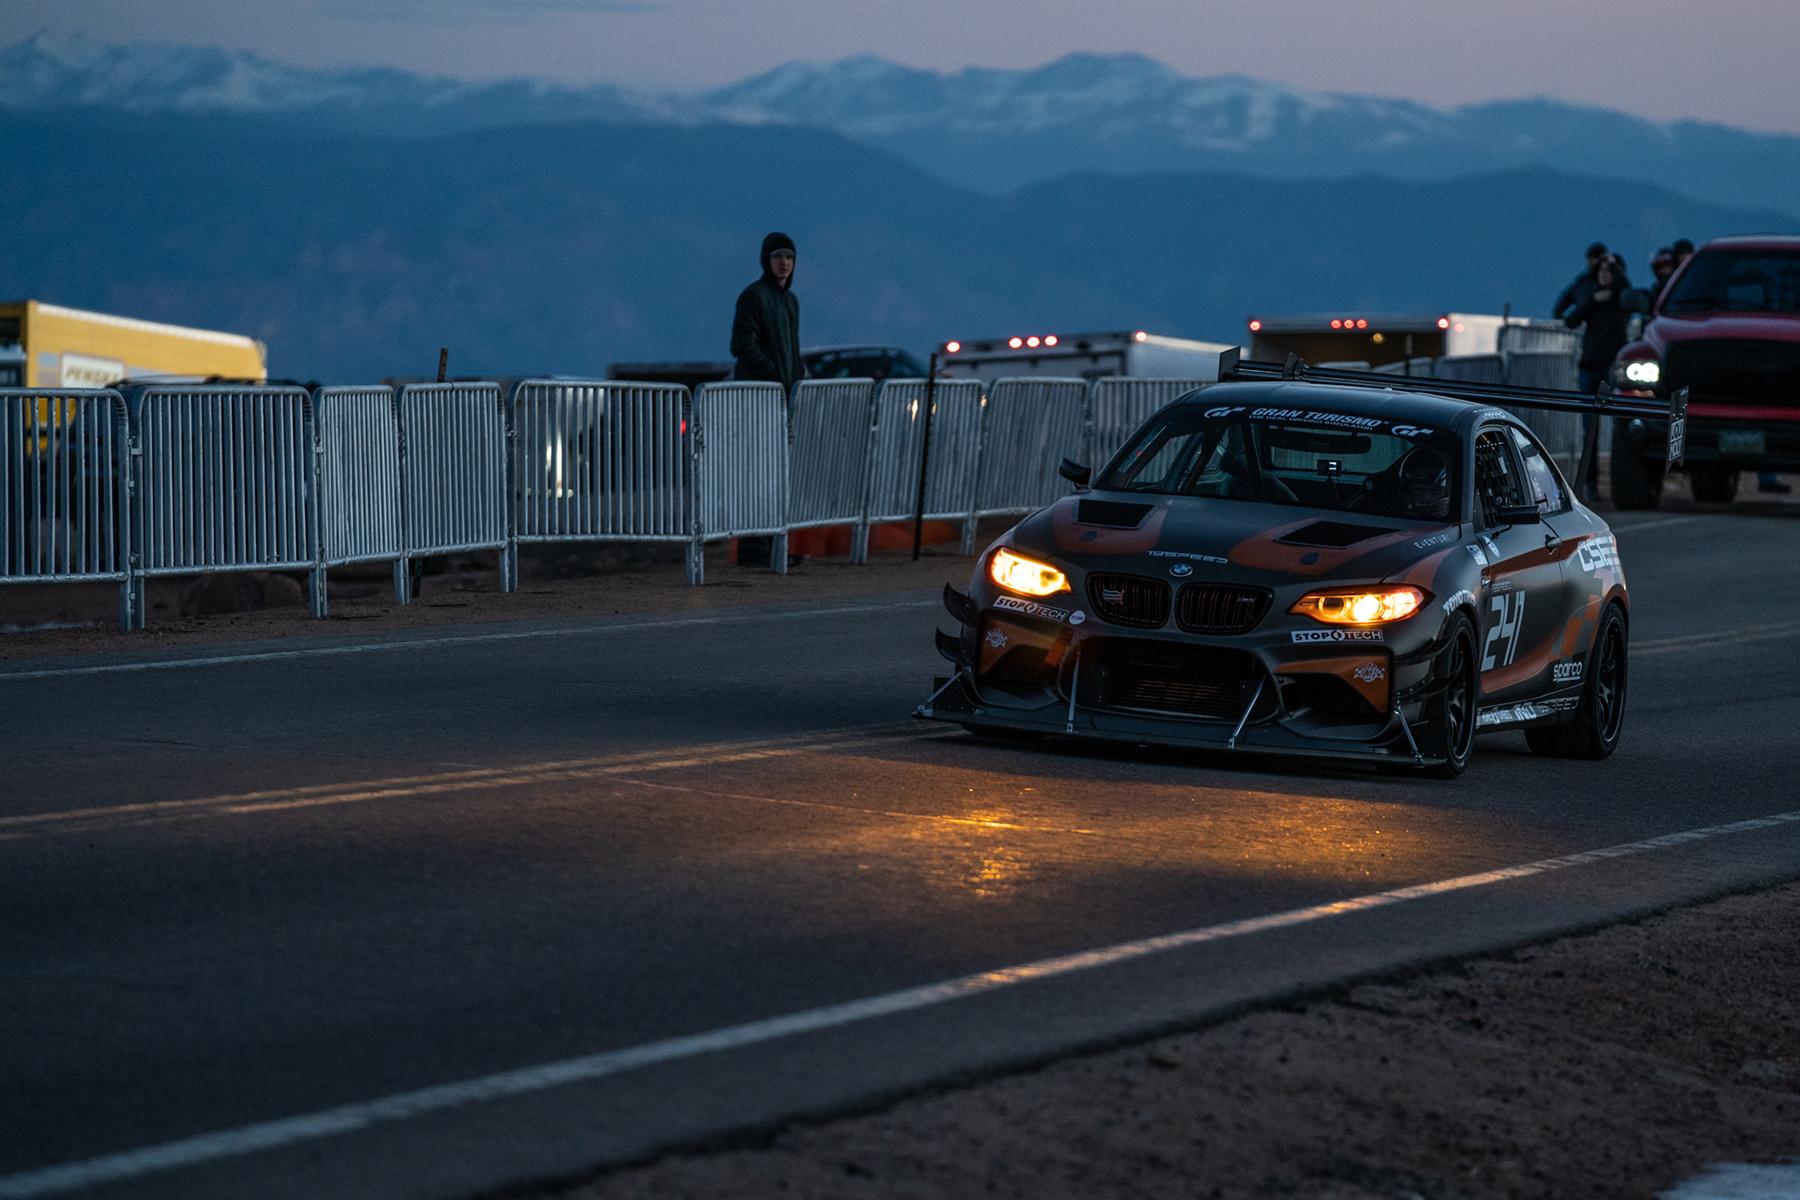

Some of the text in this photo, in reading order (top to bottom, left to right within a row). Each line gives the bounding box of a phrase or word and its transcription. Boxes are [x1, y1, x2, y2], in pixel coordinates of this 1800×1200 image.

[1251, 407, 1383, 427] GRAN TURISMO
[997, 598, 1025, 609] STOP
[1035, 607, 1067, 620] TECH
[1295, 630, 1382, 641] STOP TECH
[1553, 661, 1582, 683] sparco
